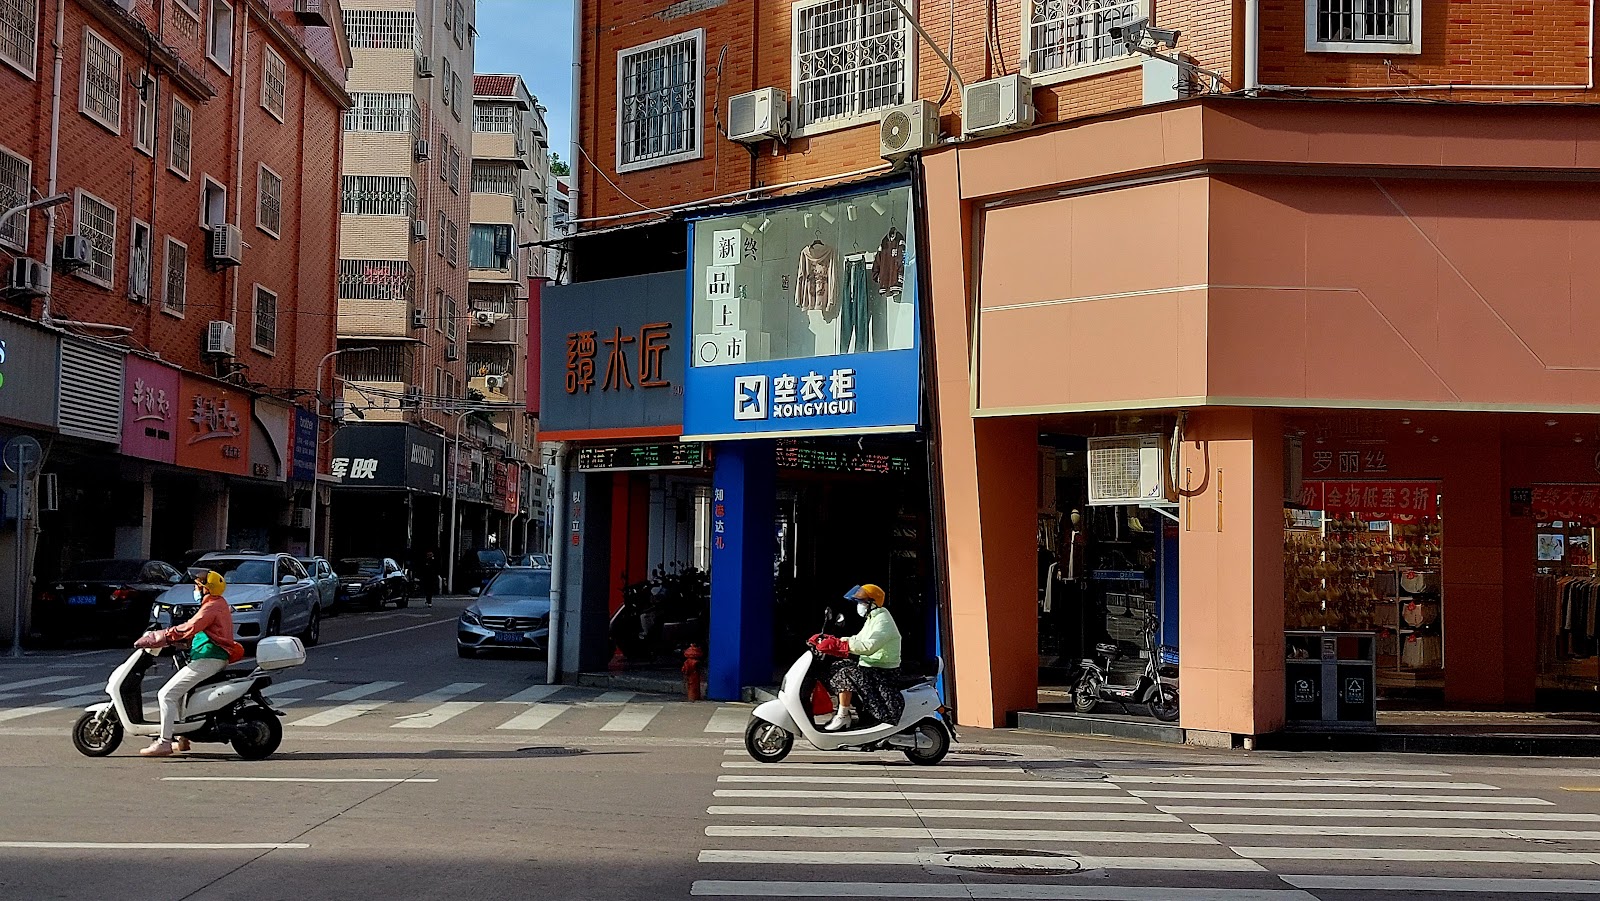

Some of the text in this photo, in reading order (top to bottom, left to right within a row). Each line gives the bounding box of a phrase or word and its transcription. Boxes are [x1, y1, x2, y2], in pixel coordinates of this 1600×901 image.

[565, 322, 672, 394] 譚木匠
[773, 368, 856, 403] 空衣柜
[1312, 450, 1388, 473] 罗丽丝
[1327, 486, 1430, 510] 全场低至3折
